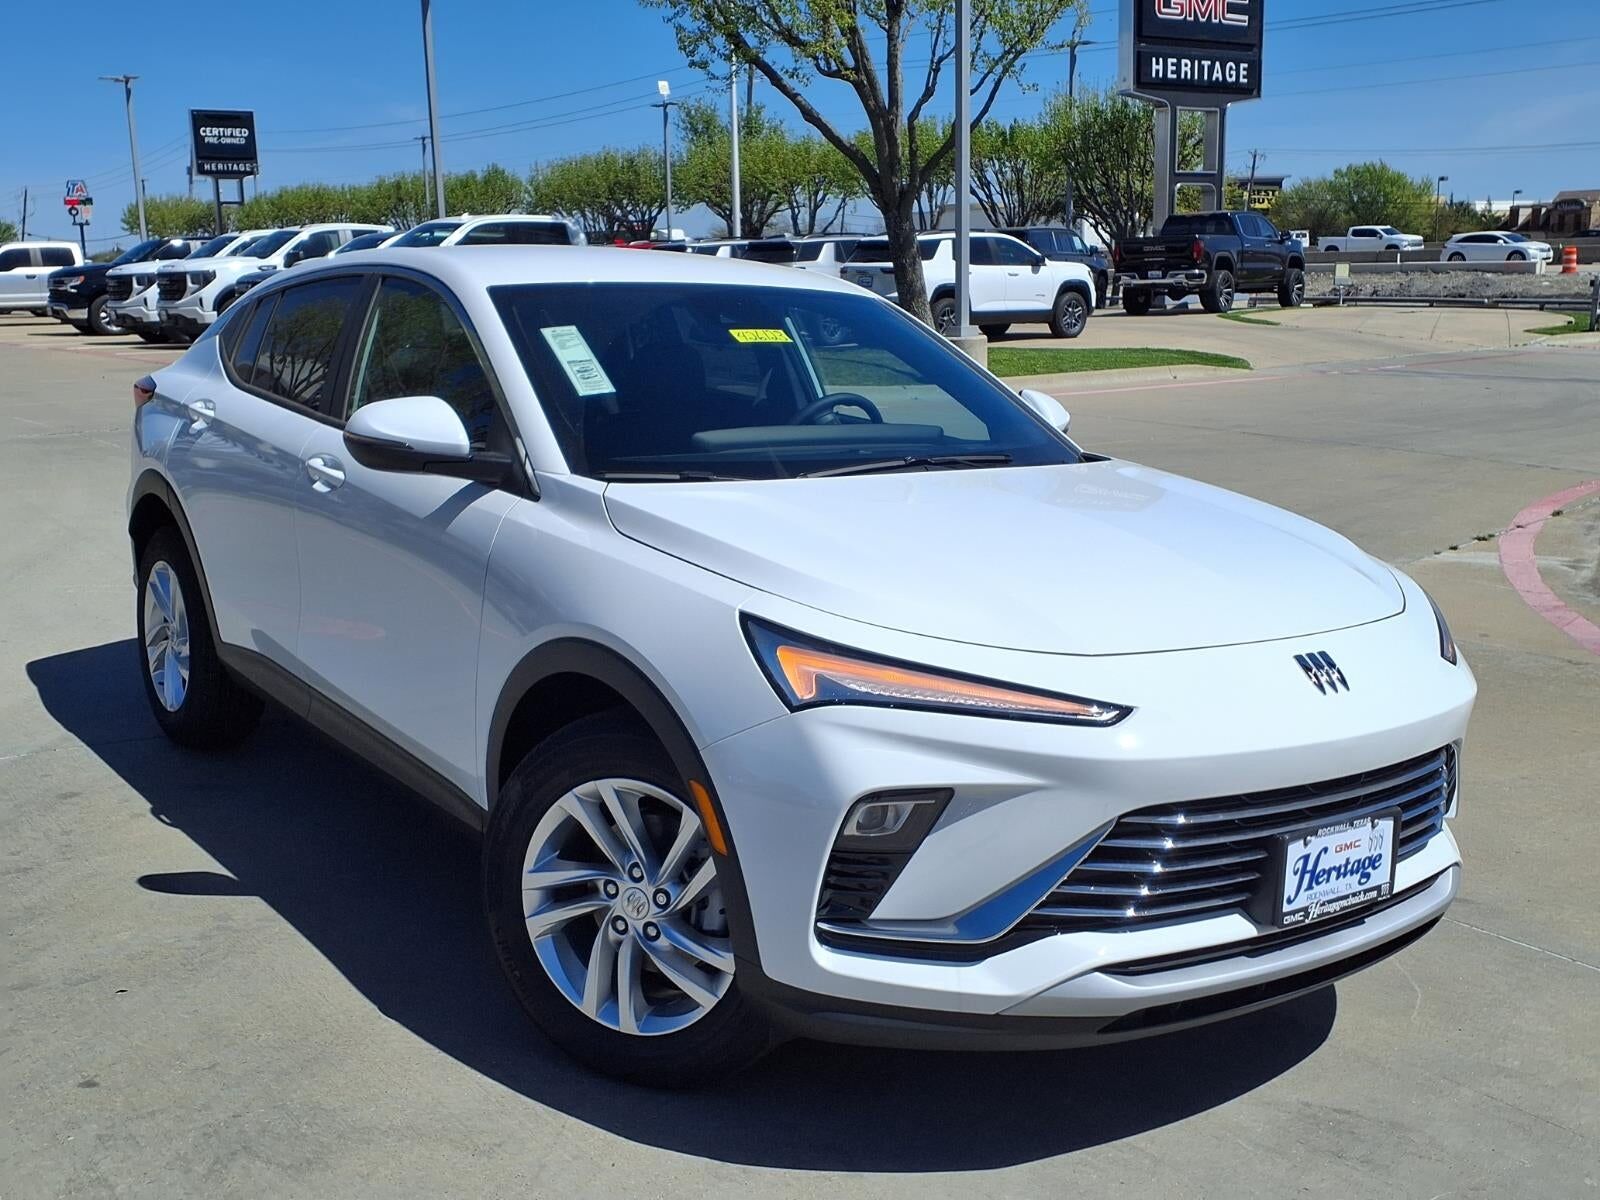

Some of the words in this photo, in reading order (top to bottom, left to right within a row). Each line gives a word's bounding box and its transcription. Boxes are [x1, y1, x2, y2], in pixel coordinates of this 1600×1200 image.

[1155, 0, 1249, 26] GMC
[1151, 57, 1249, 83] HERITAGE
[199, 127, 250, 137] CERTIFIED
[204, 136, 246, 144] PRE-OWNED
[204, 163, 251, 171] HERITAGE
[1250, 197, 1274, 205] BUY
[1334, 839, 1362, 854] GMC
[1286, 846, 1383, 905] Heritage
[1283, 912, 1305, 925] GMC
